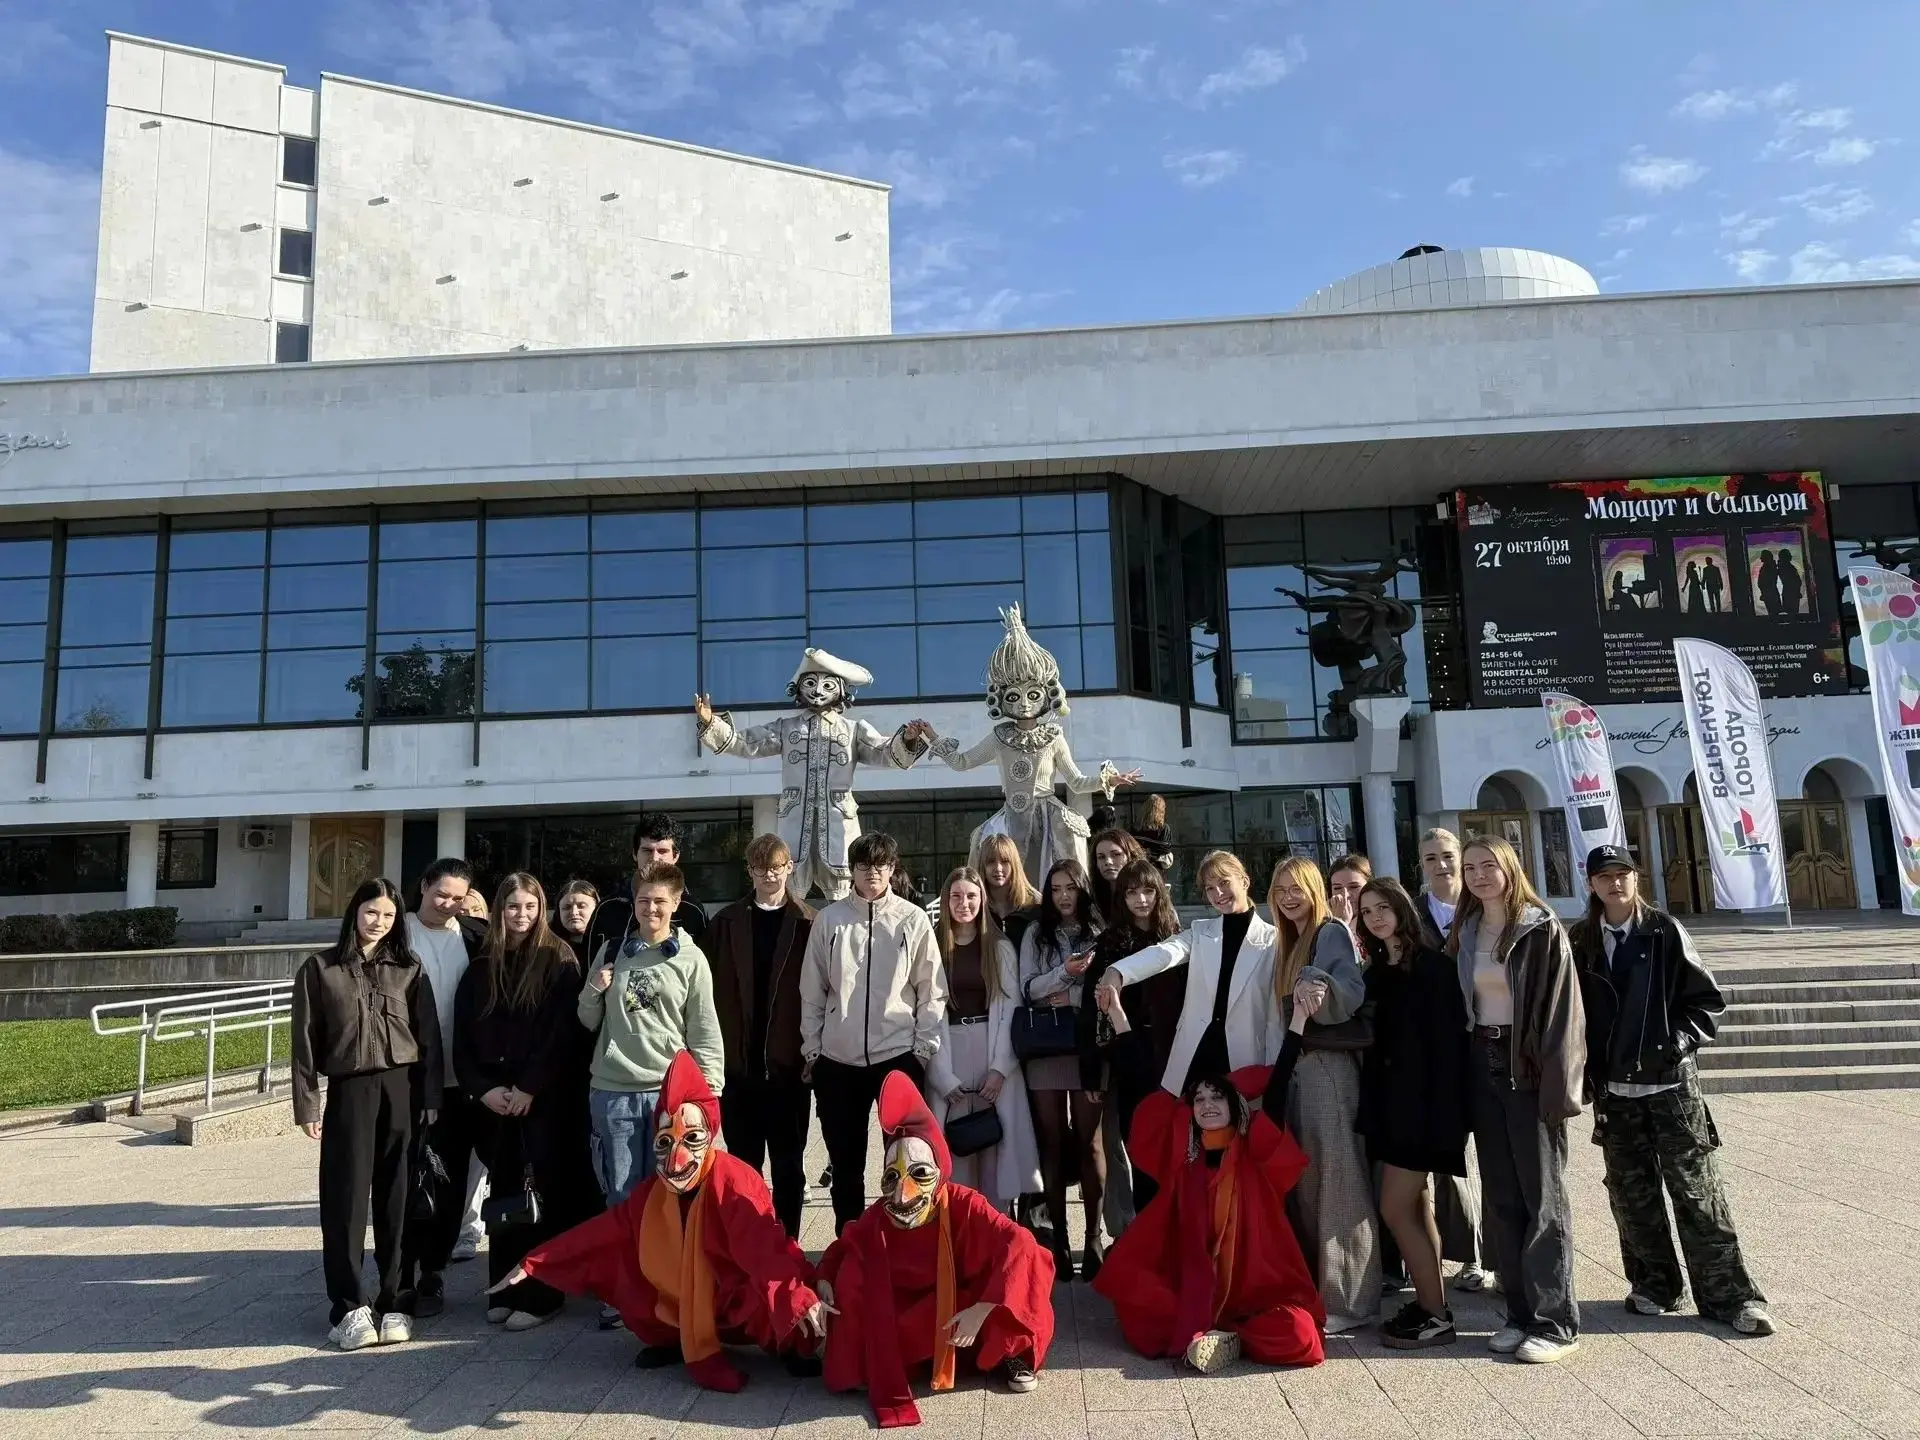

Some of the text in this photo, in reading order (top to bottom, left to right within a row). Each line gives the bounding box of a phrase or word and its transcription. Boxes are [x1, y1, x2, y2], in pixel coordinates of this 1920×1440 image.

[1584, 496, 1678, 523] Моцарт
[1686, 497, 1700, 516] и
[1706, 491, 1809, 516] Сальери
[1474, 536, 1570, 568] 27 октября
[1545, 555, 1571, 566] 19:00
[1496, 631, 1557, 639] ПУШКИНСКАЯ
[1480, 651, 1523, 659] 254-56-66
[1481, 658, 1559, 669] БИЛЕТЫ НА САЙТЕ
[1482, 668, 1549, 678] KONCERTZAL.RU
[1812, 672, 1830, 684] 6+
[1483, 679, 1489, 687] И
[1499, 678, 1526, 686] КАССЕ
[1527, 675, 1595, 686] ВОРОНЕЖСКОГО
[1484, 686, 1544, 697] КОНЦЕРТНОГО
[1601, 845, 1618, 857] LA
